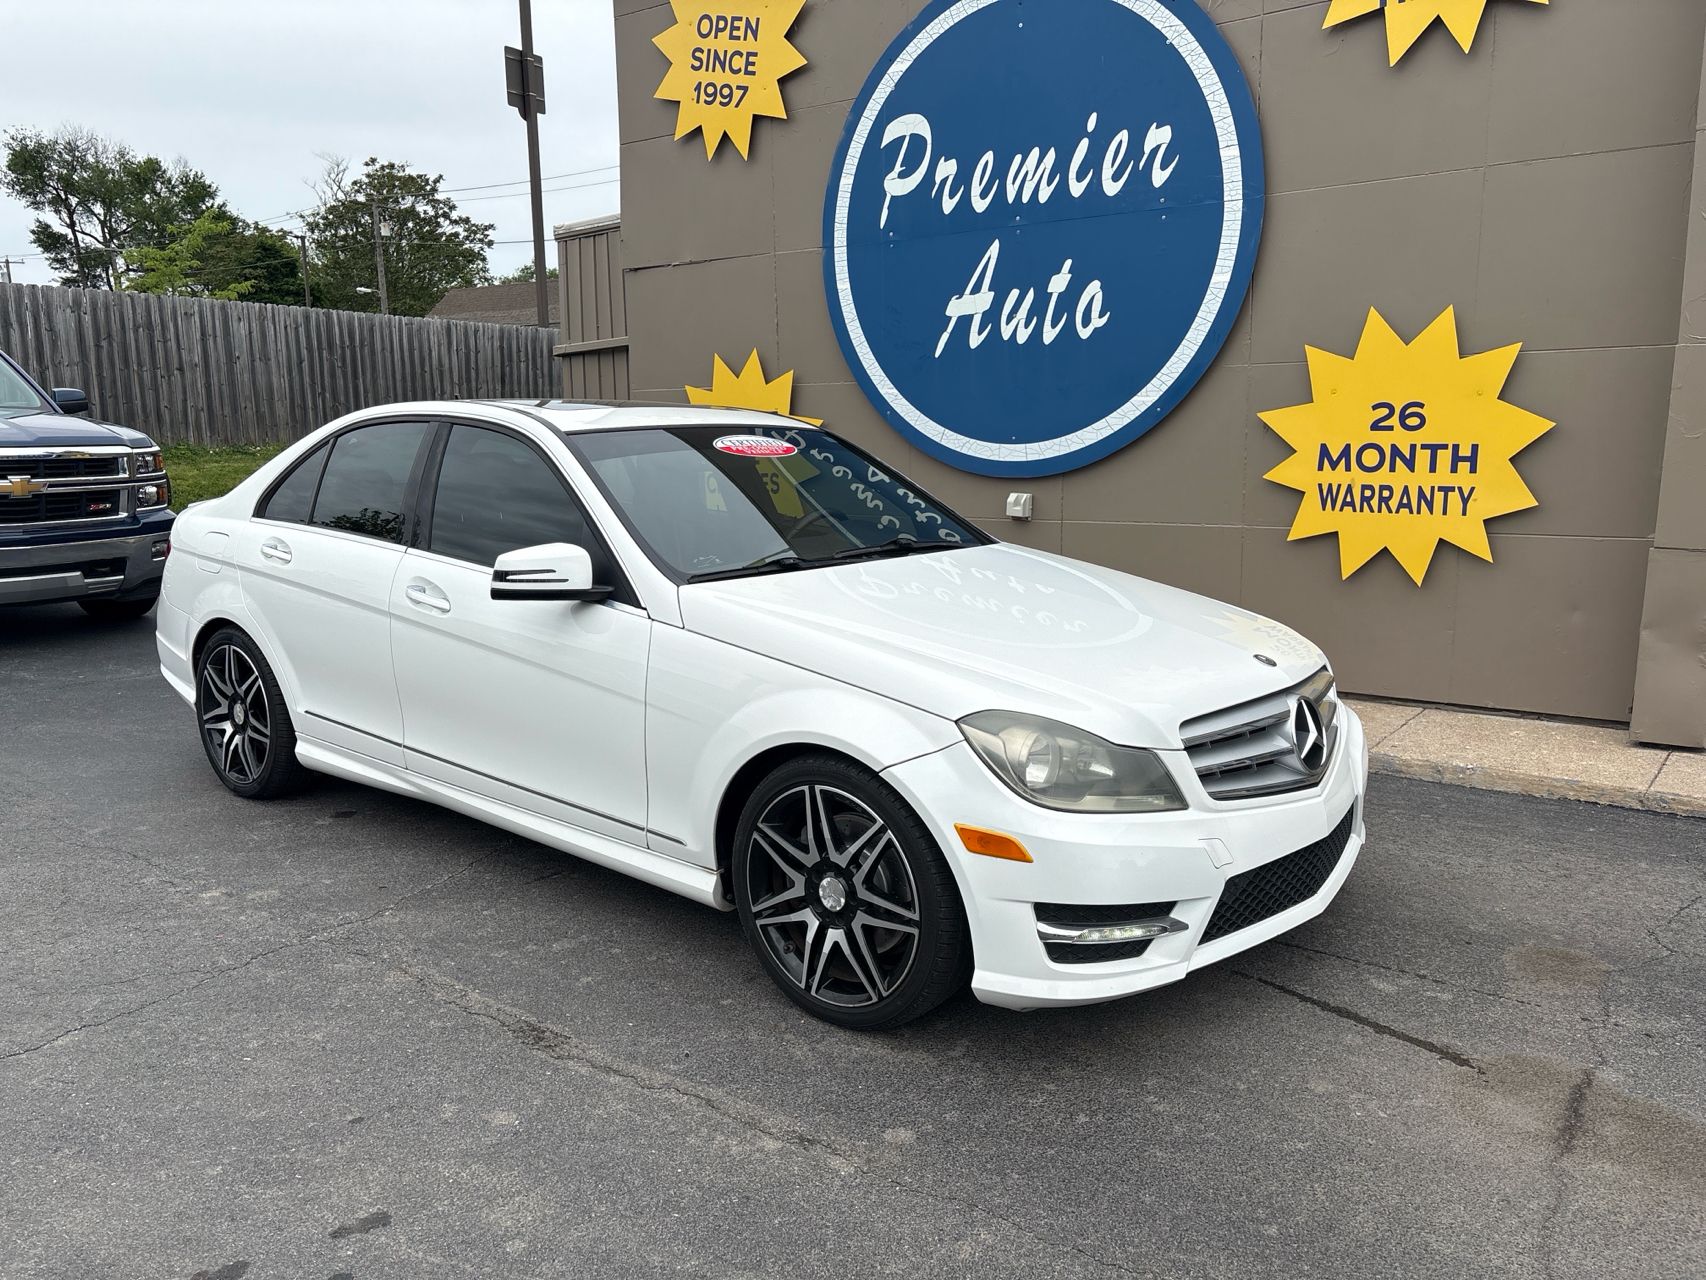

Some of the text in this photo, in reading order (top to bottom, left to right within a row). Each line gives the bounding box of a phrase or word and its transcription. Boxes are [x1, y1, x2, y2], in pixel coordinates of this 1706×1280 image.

[697, 14, 760, 42] OPEN
[690, 47, 758, 76] SINCE
[694, 81, 749, 108] 1997
[880, 112, 1179, 229] Premier
[935, 238, 1110, 358] Auto
[1370, 401, 1426, 432] 26
[1317, 443, 1479, 474] MONTH
[1317, 483, 1476, 516] WARRANTY
